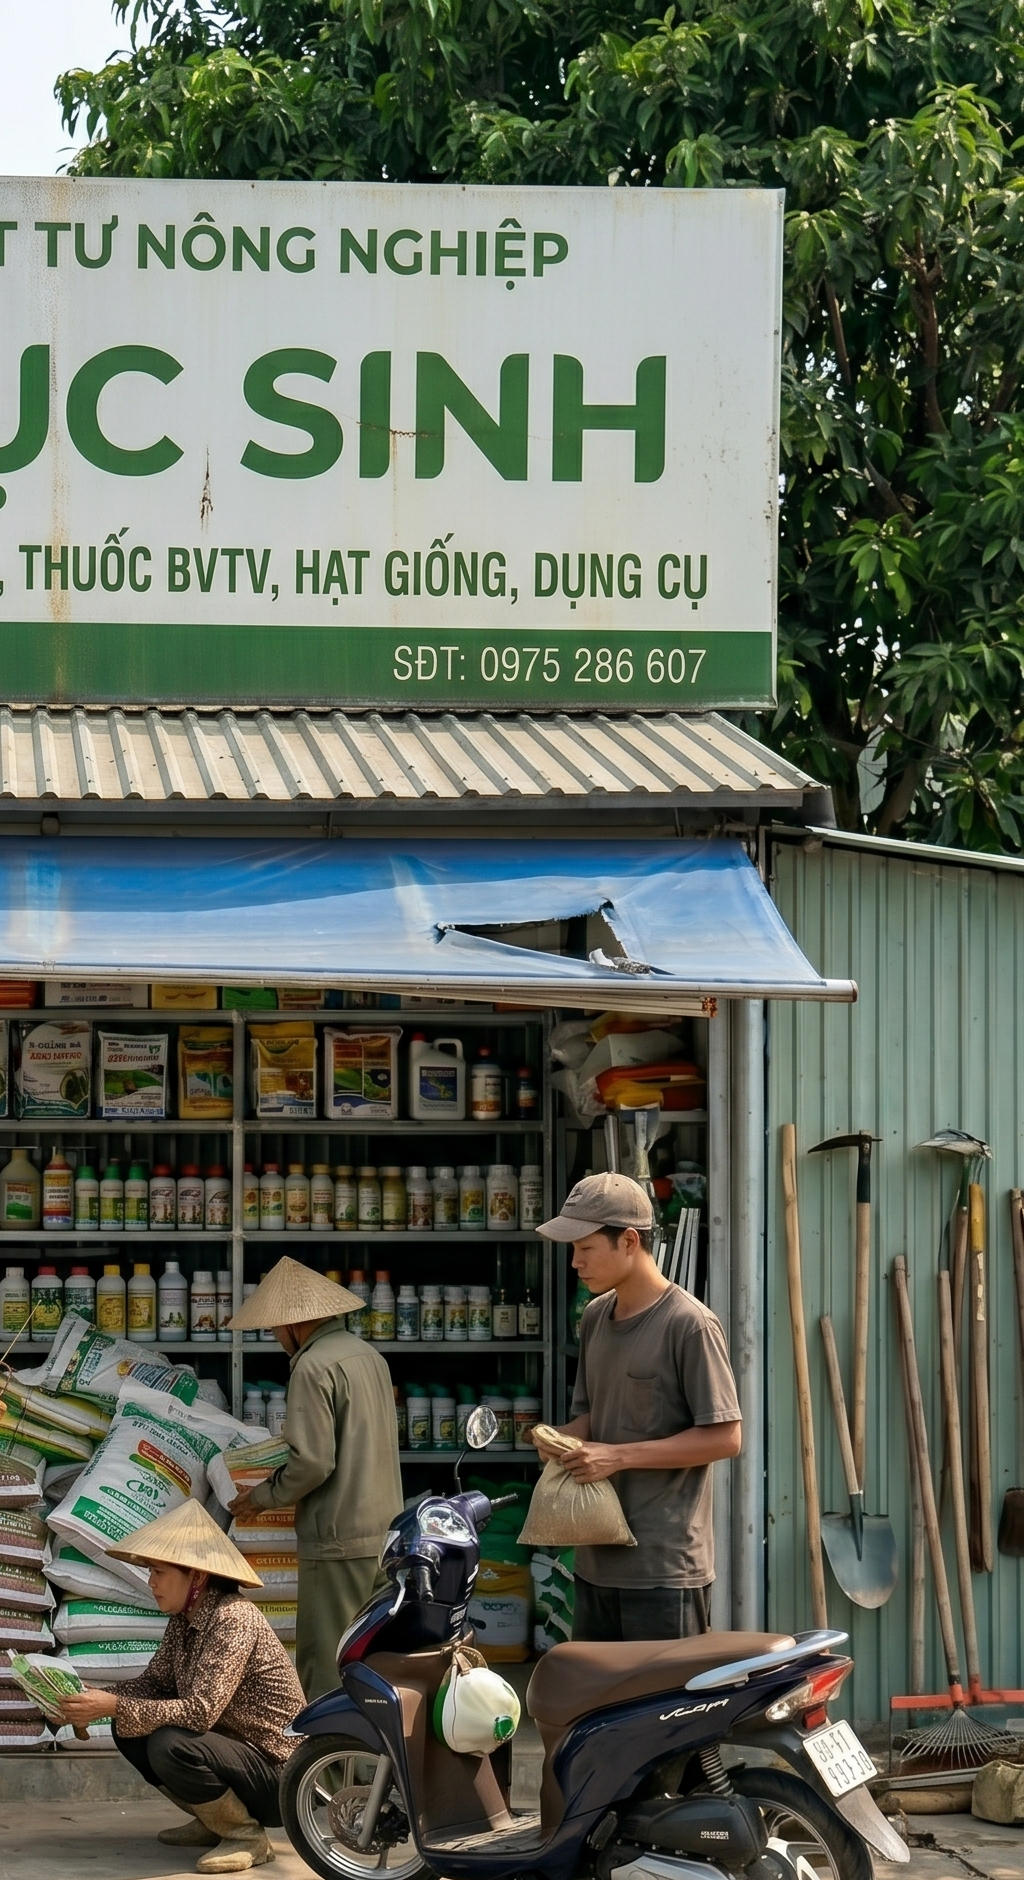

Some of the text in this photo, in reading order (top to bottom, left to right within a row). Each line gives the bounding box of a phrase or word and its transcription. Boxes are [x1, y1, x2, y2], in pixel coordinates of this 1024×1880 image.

[35, 215, 119, 269] TƯ
[137, 212, 317, 274] NÔNG
[340, 218, 569, 291] NGHIỆP
[240, 347, 666, 484] SINH
[19, 527, 152, 593] THUỐC
[167, 547, 280, 601] BVTV,
[295, 549, 370, 605] HẠT
[383, 533, 519, 604] GIỐNG,
[534, 553, 642, 610] DỤNG
[657, 554, 708, 612] CỤ
[393, 646, 707, 684] SĐT: 0975 286 607
